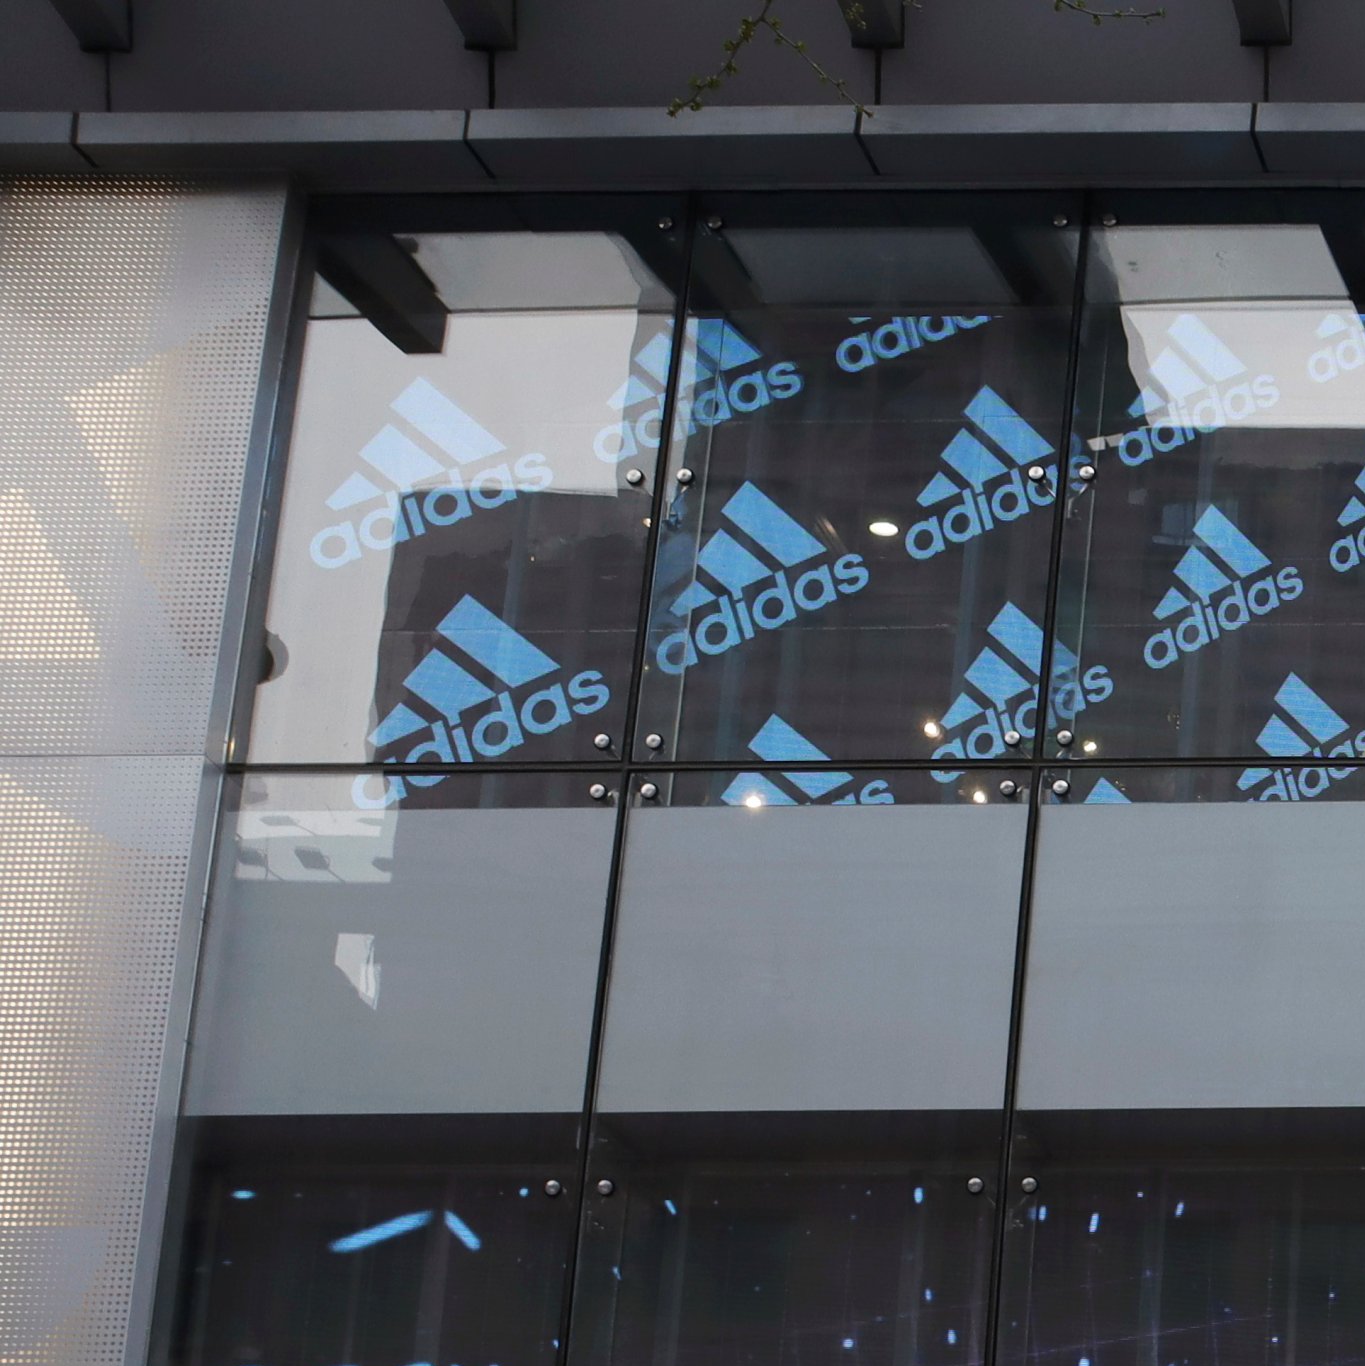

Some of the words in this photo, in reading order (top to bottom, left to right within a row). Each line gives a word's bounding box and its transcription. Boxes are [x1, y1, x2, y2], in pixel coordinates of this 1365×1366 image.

[1118, 374, 1280, 466] adidas
[310, 452, 554, 569] adidas
[656, 552, 869, 675] adidas
[1143, 566, 1304, 670] adidas
